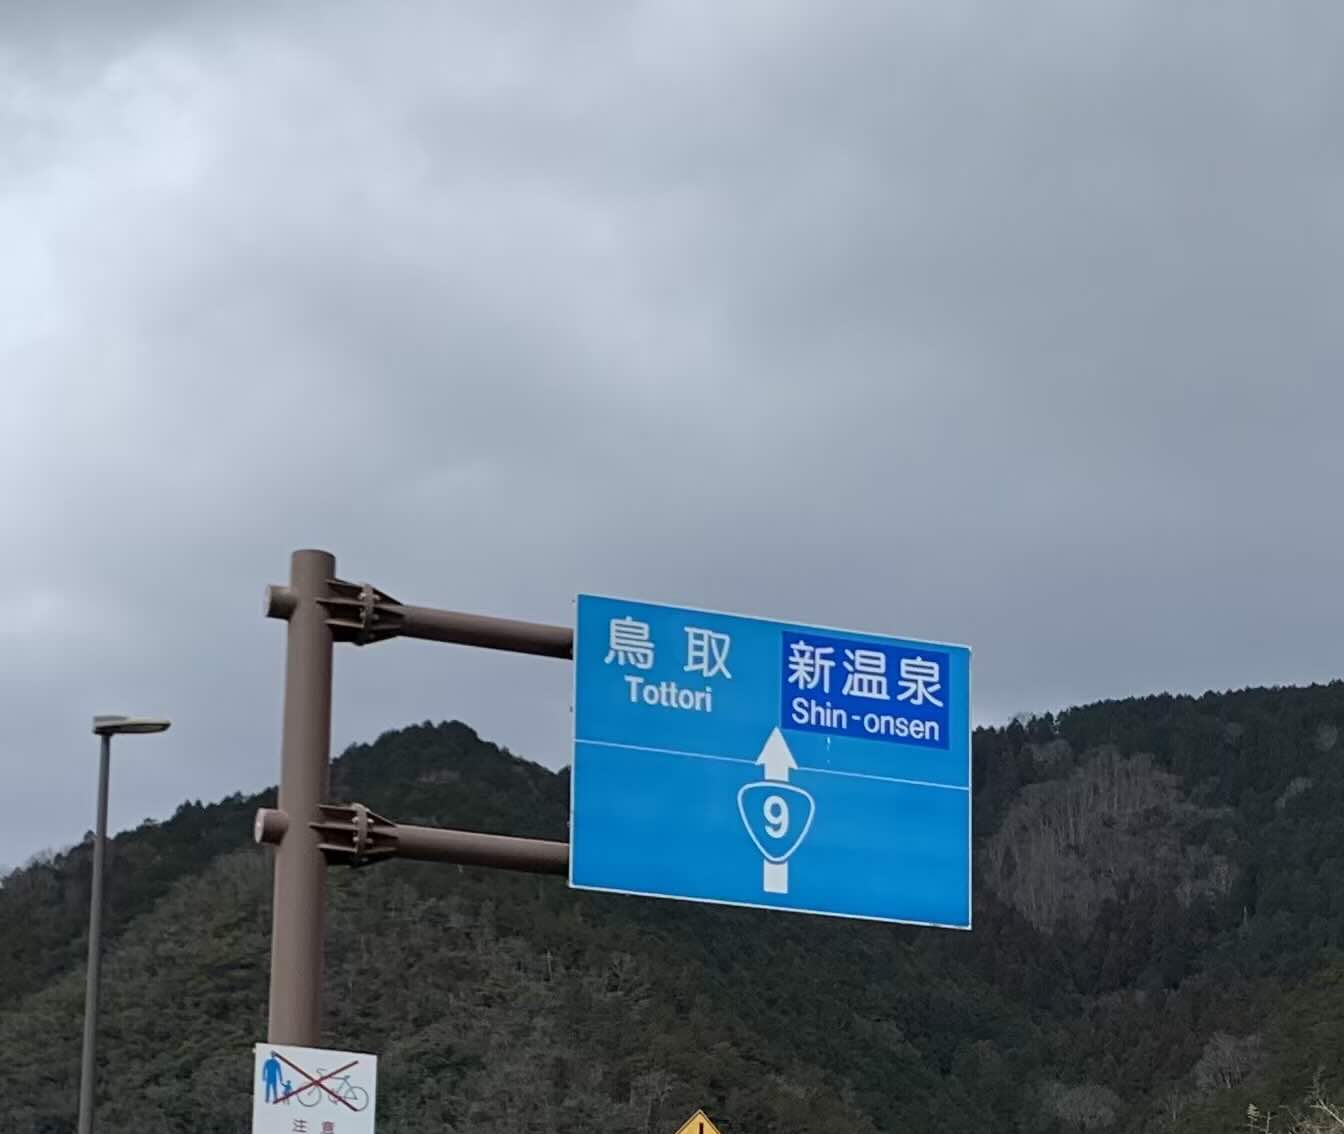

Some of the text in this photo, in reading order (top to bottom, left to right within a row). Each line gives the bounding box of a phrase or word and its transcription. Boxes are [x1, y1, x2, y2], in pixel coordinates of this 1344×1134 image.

[603, 615, 733, 679] 鳥取
[787, 639, 944, 708] 新温泉
[623, 674, 714, 713] Tottori
[763, 795, 790, 838] 9
